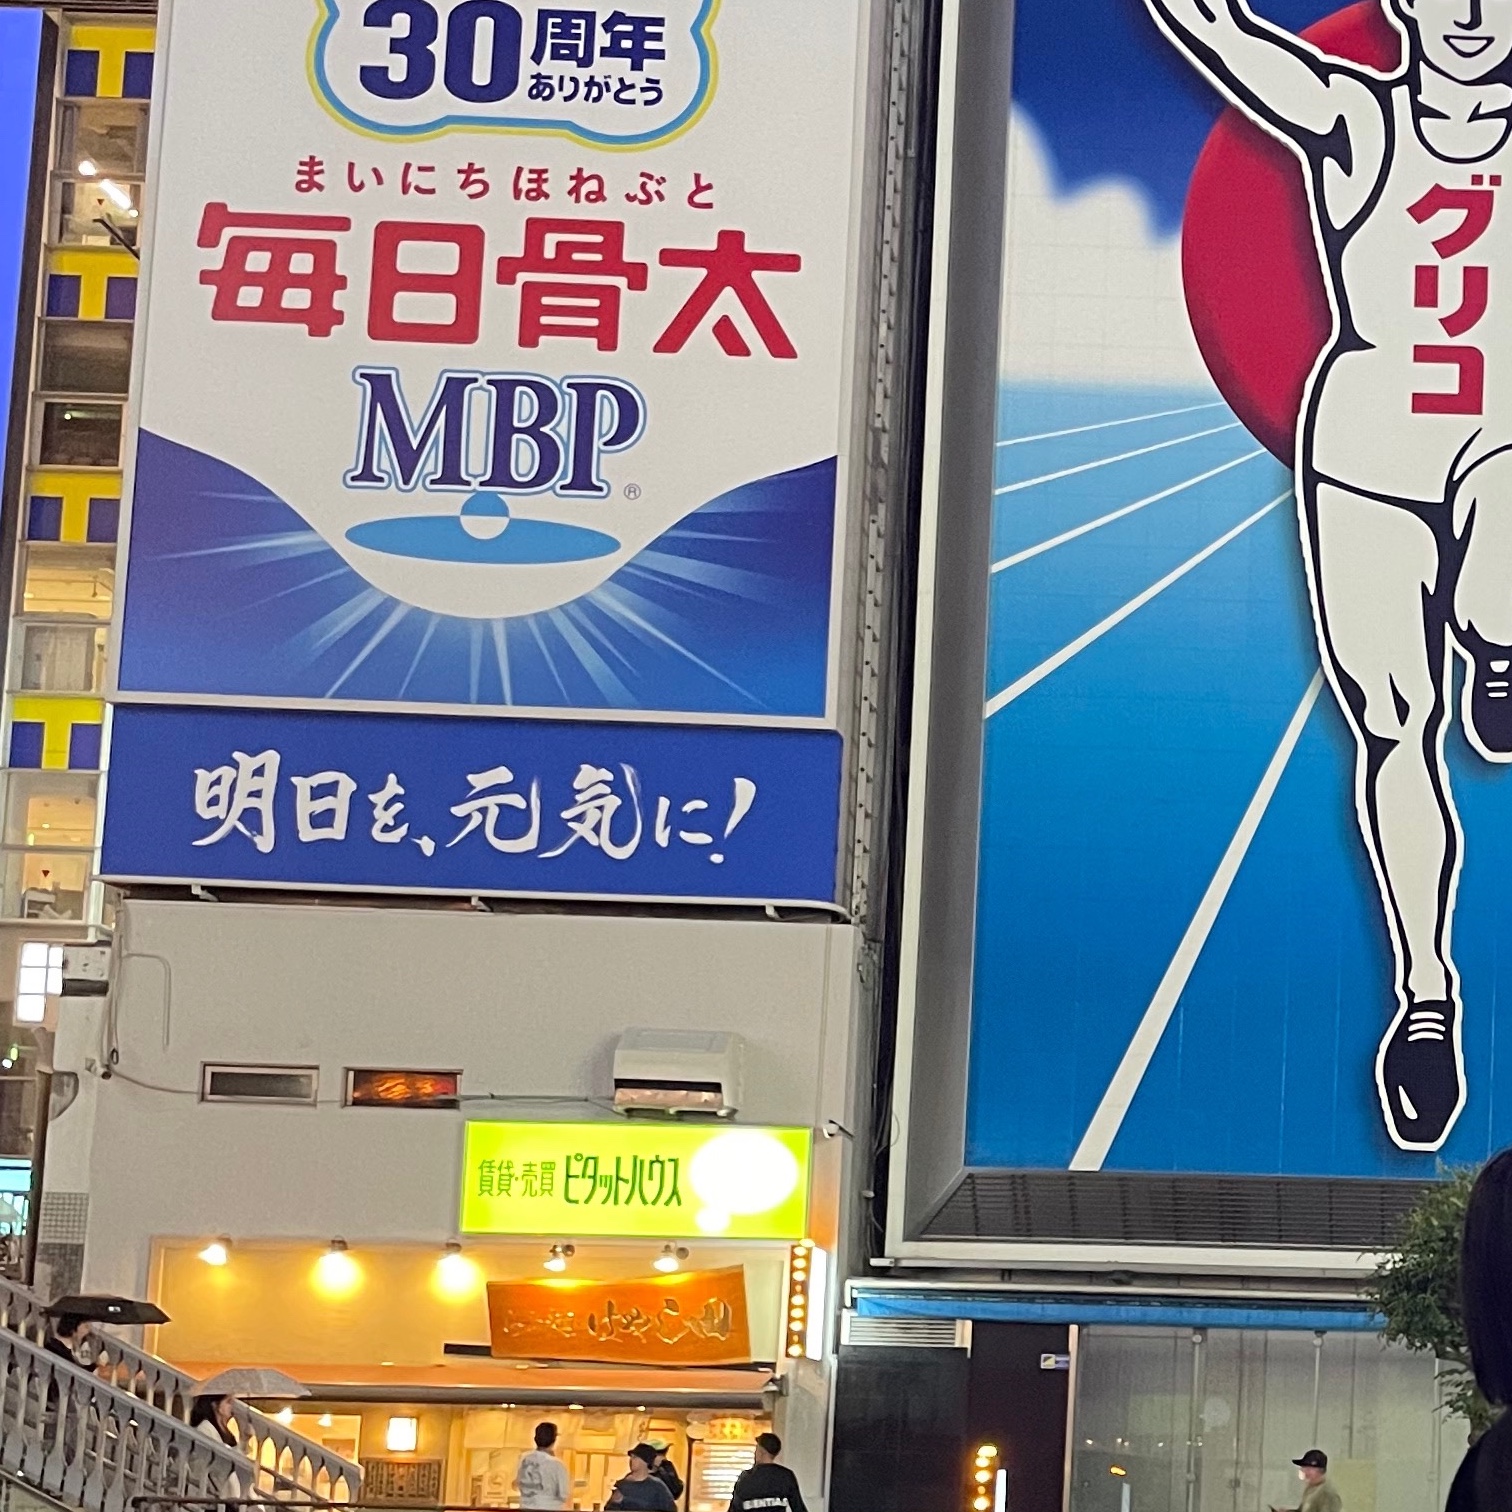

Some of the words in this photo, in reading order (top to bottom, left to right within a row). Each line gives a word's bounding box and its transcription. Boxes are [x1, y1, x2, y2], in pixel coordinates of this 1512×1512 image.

[527, 72, 666, 108] ありがとう
[294, 155, 716, 210] まいにちほねぶと
[197, 202, 802, 359] 毎日骨太
[1406, 173, 1502, 416] グリコ
[345, 367, 646, 500] MBP
[564, 1153, 682, 1207] ピタットハウス
